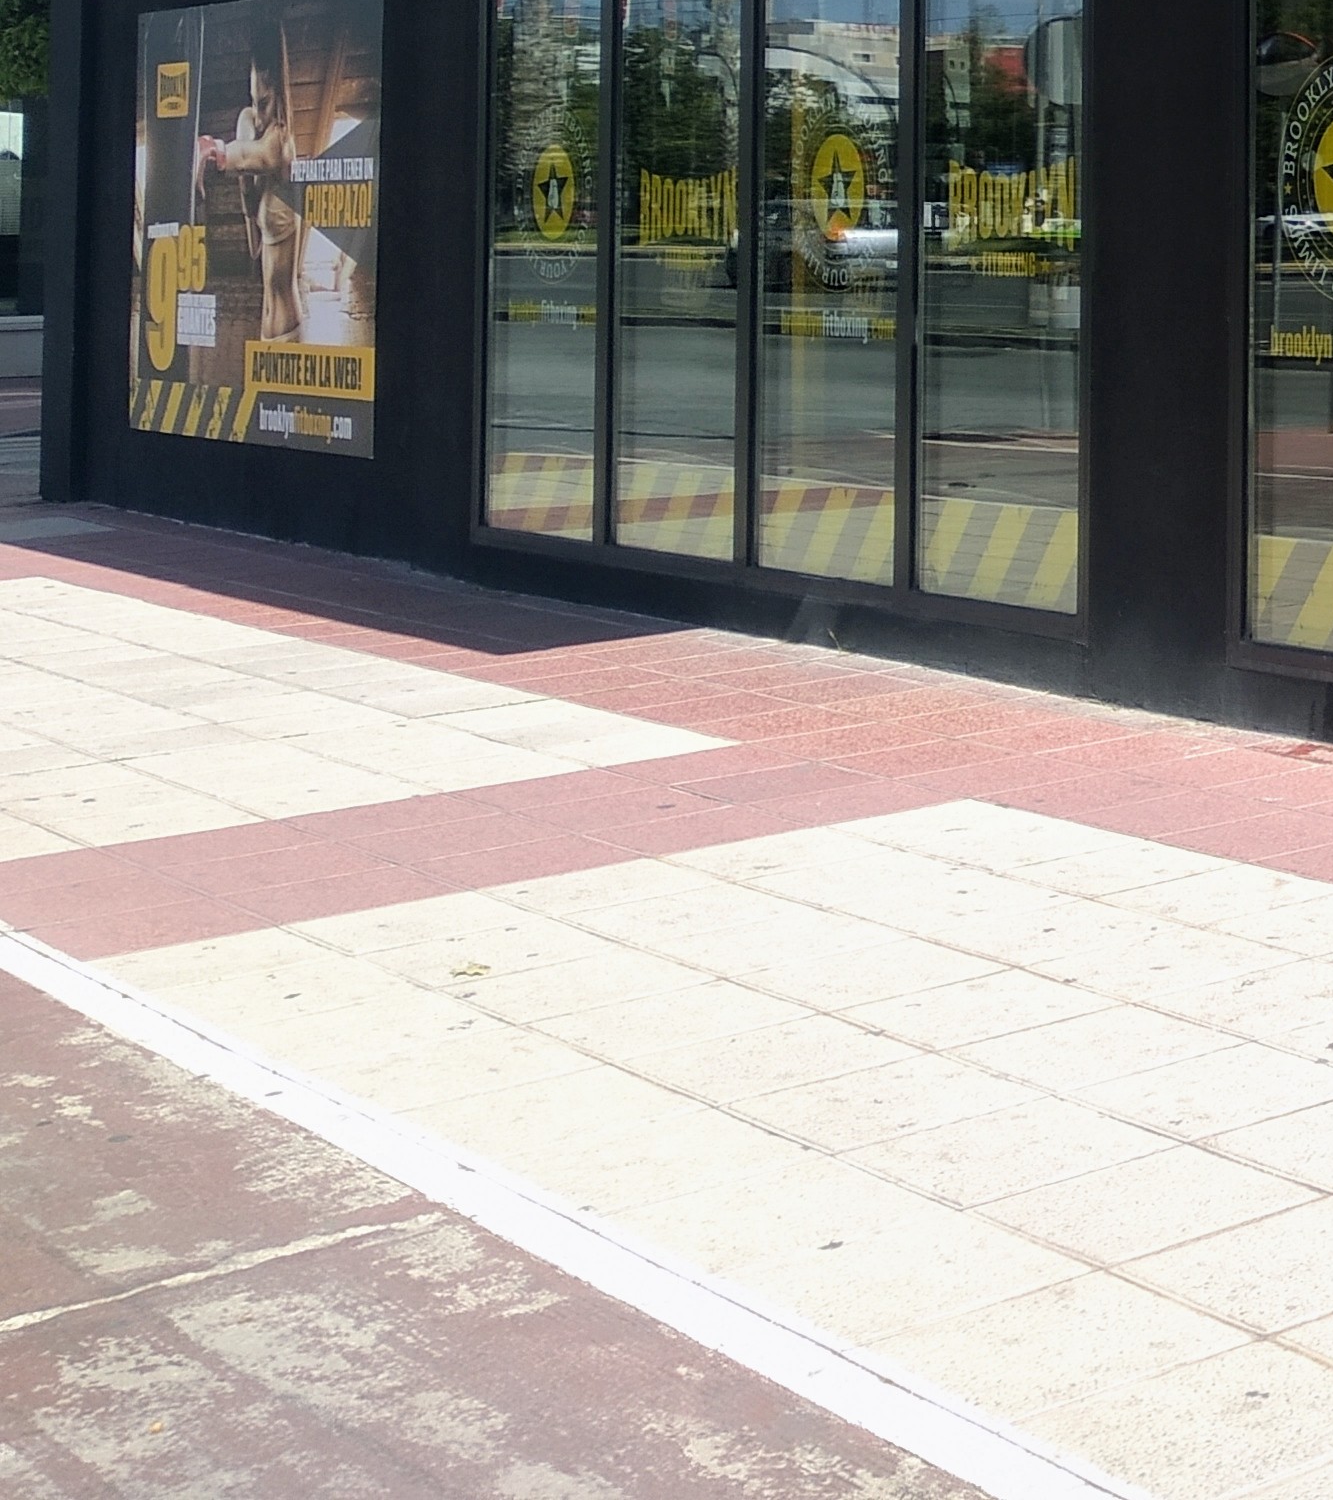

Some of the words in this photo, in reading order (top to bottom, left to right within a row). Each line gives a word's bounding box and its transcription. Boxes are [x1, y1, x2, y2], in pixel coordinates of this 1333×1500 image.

[305, 180, 373, 228] CUERPAZO!
[639, 165, 738, 247] BROOKLYN
[948, 155, 1076, 252] BROOKLYN
[252, 345, 303, 386] APÚNTATE
[304, 354, 318, 387] EN
[318, 355, 332, 388] LA
[333, 356, 362, 391] WEB!
